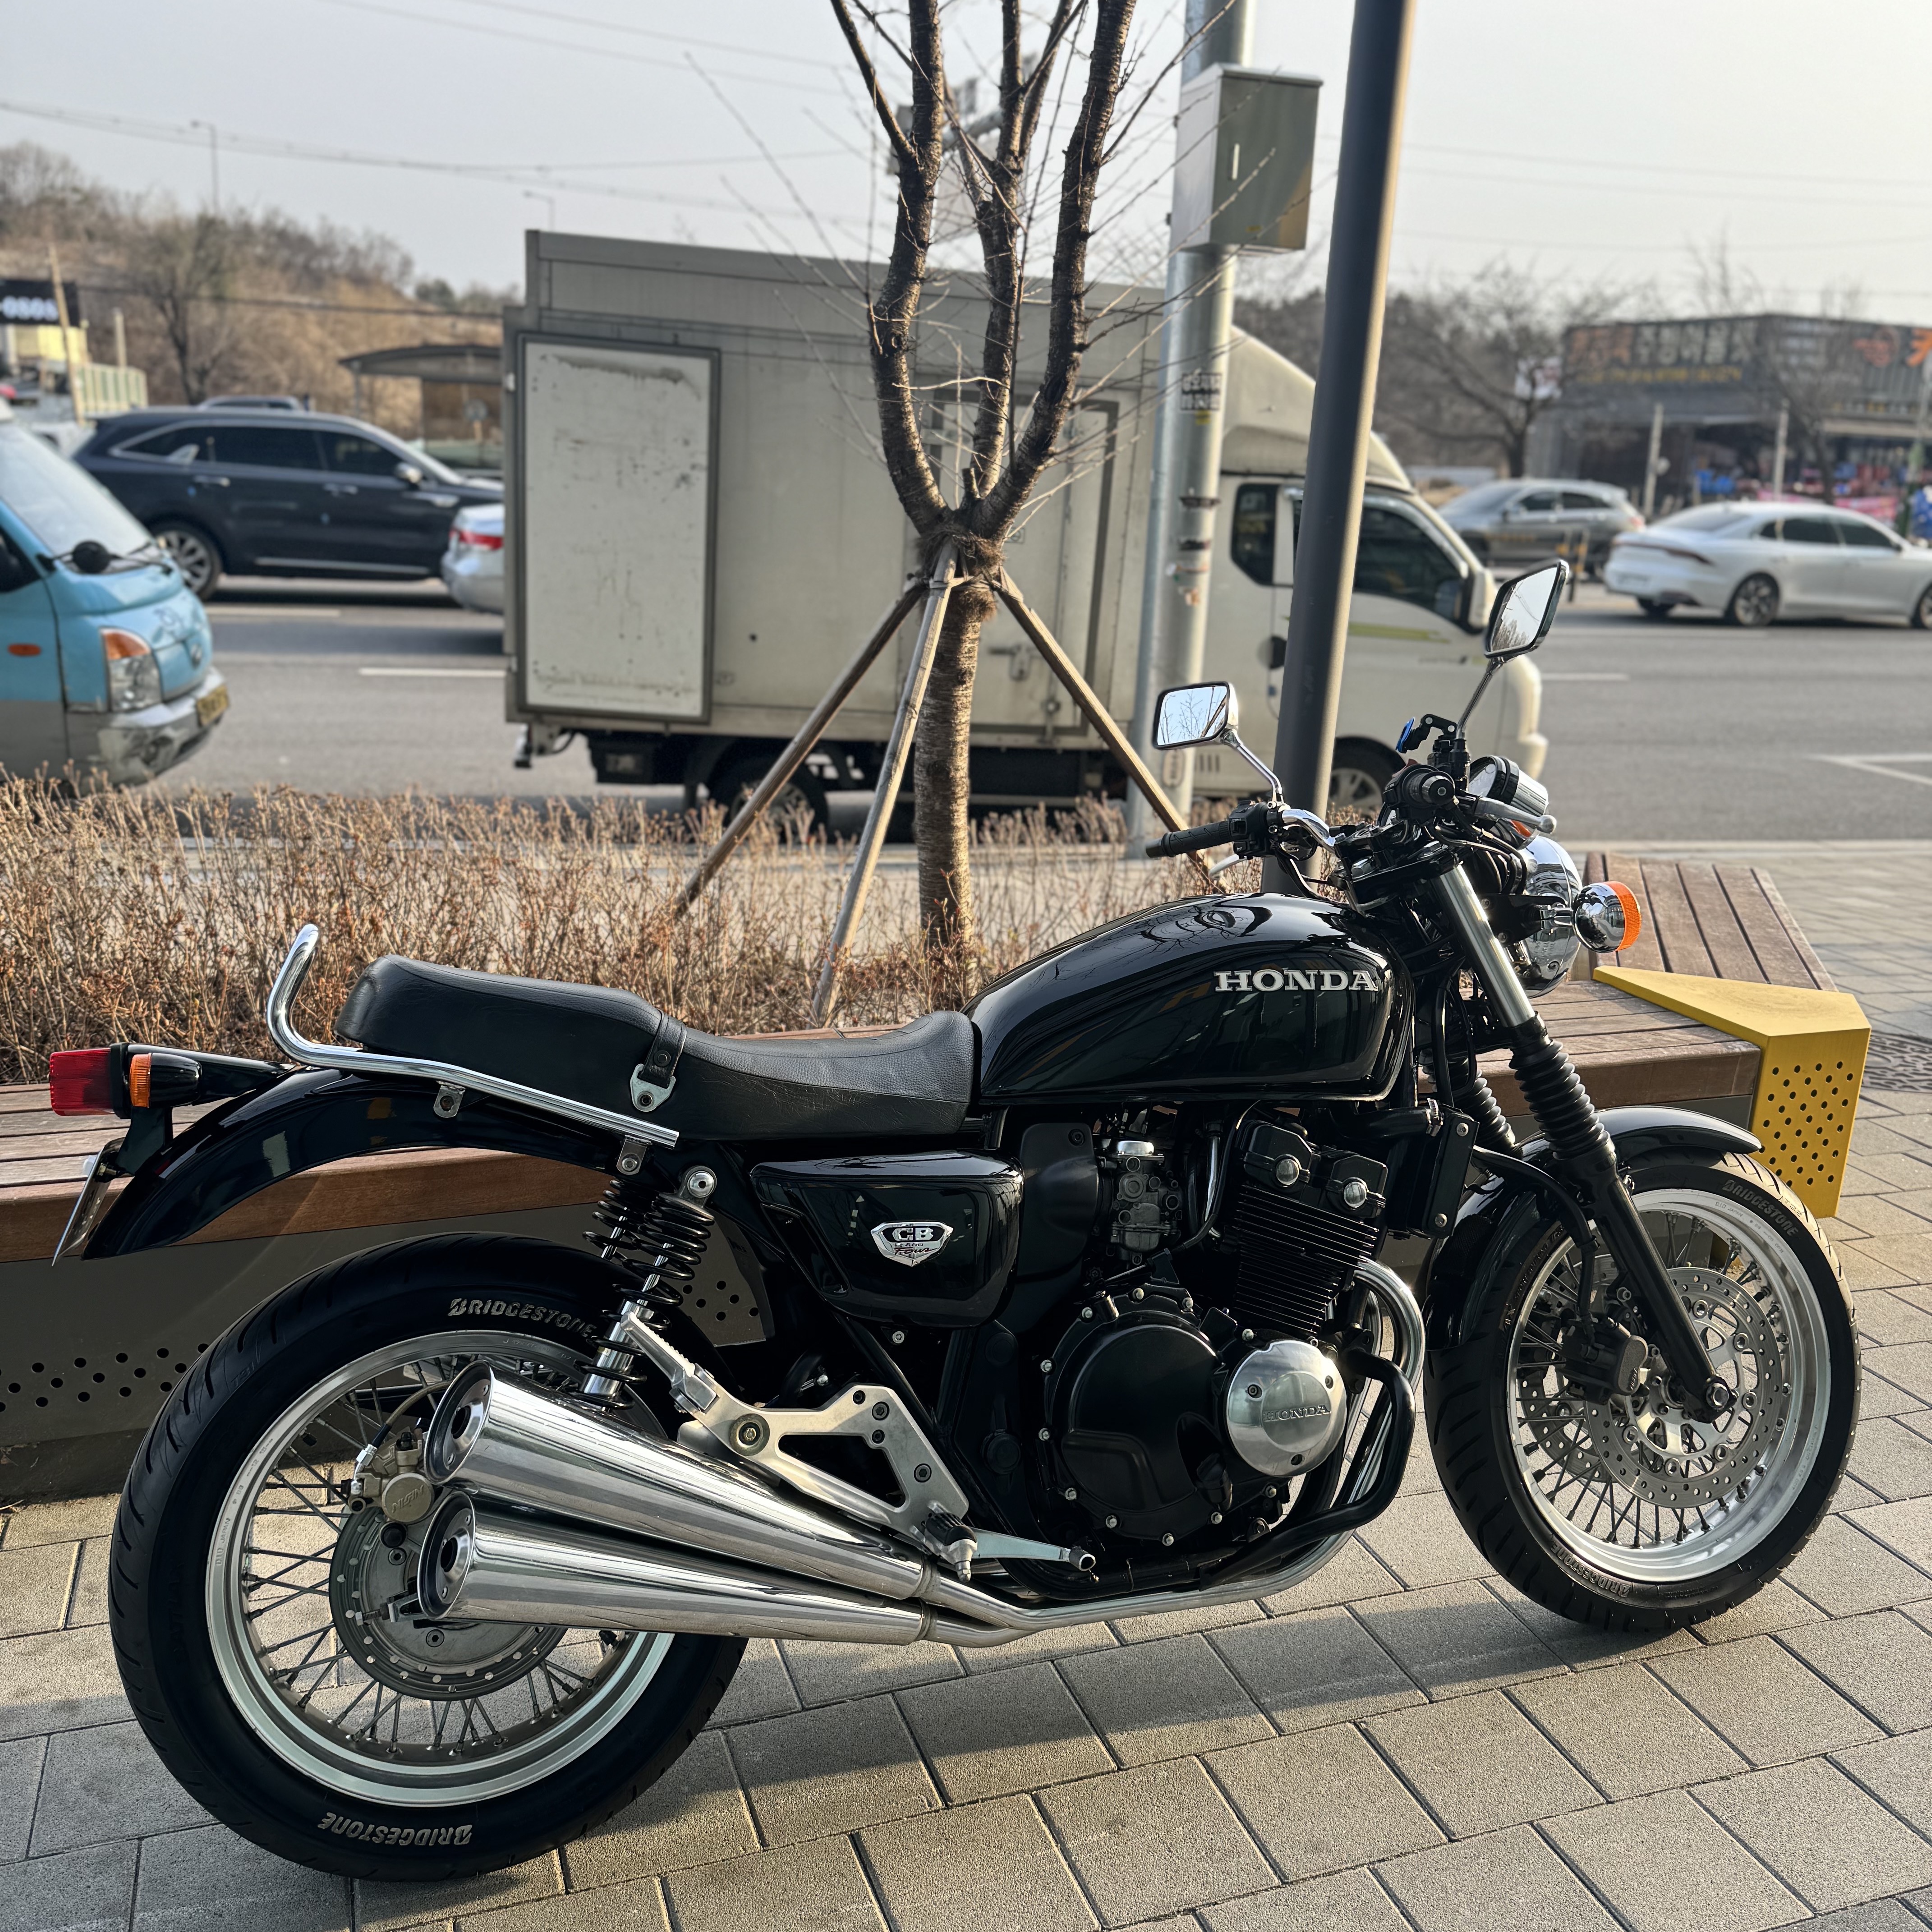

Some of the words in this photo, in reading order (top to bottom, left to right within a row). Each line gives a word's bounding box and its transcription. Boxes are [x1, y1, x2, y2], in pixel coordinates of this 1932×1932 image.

[1214, 969, 1378, 992] HONDA
[1722, 1179, 1799, 1236] BRIDGESTONE
[892, 1228, 933, 1240] CB
[448, 1298, 597, 1338] BRIDGESTONE
[1263, 1404, 1331, 1421] HONDA
[391, 1485, 424, 1513] NISSIN
[221, 1518, 230, 1543] JAPAN
[1550, 1545, 1631, 1597] BRIDGESTONE
[317, 1812, 472, 1846] BRIDGESTONE
